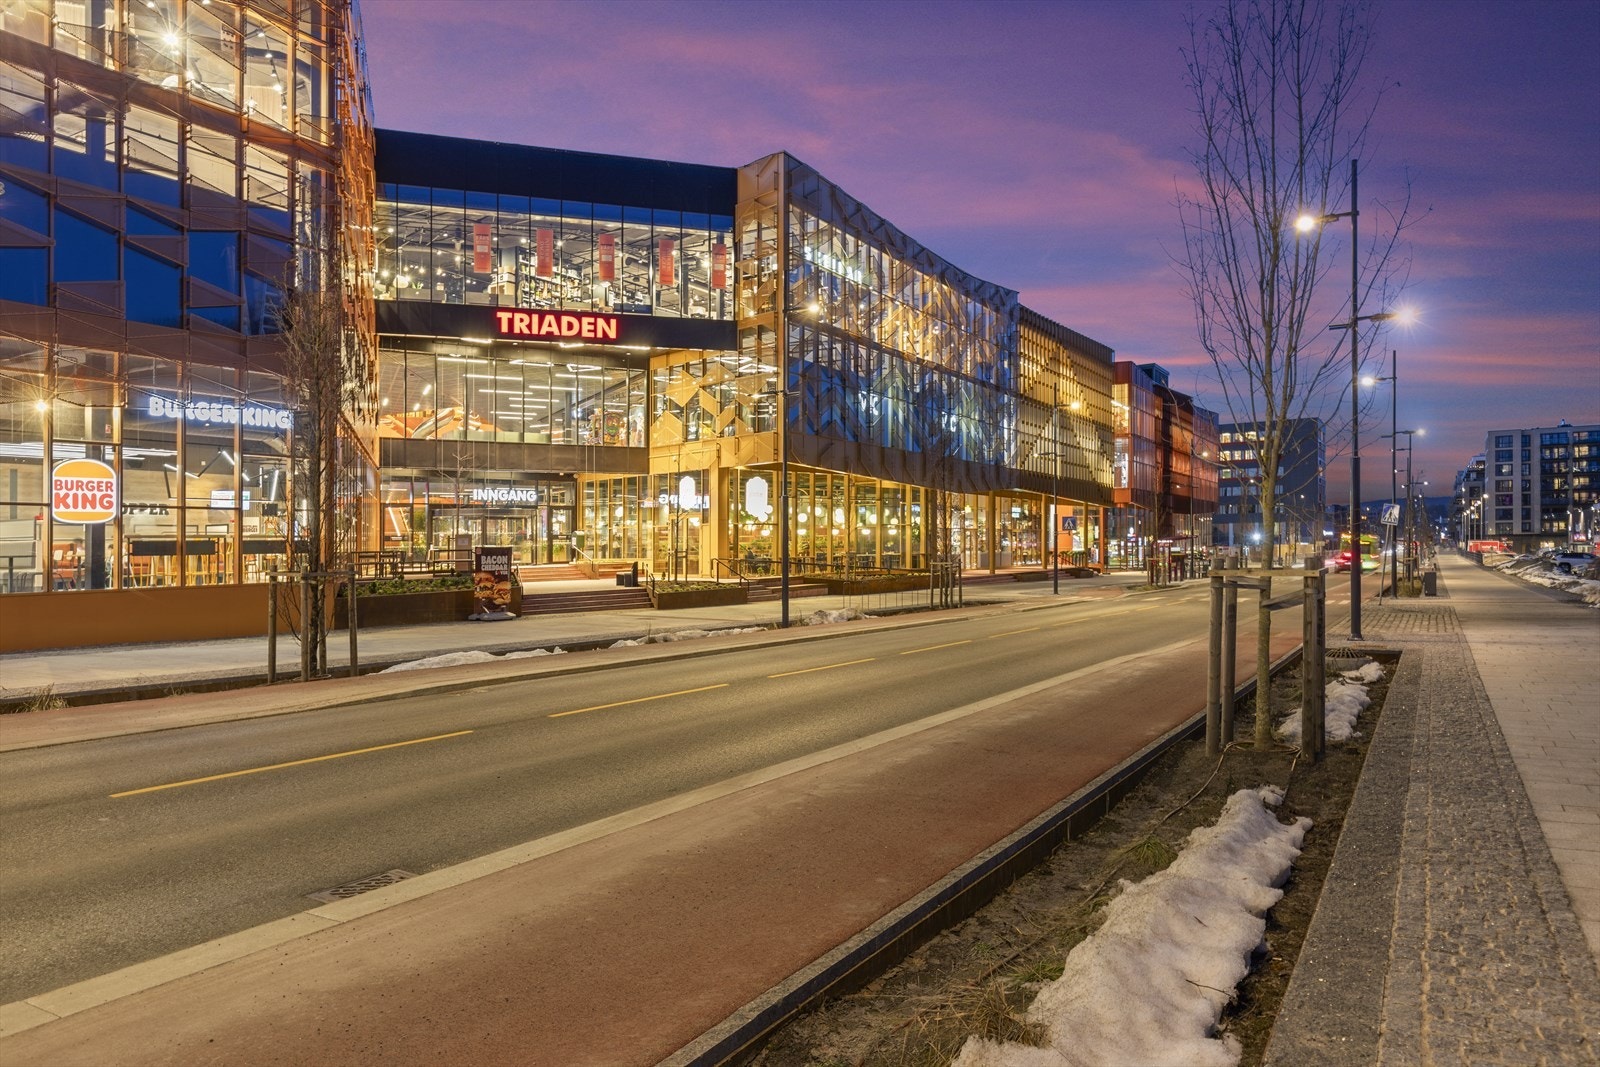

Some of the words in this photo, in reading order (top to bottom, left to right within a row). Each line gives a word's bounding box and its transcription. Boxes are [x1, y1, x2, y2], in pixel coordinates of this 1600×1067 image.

[496, 311, 617, 339] TRIADEN
[148, 396, 240, 424] BURGER
[241, 406, 292, 429] KING
[53, 479, 114, 492] BURGER
[53, 492, 114, 511] KING
[472, 488, 537, 502] INNGANG
[481, 555, 508, 565] BACON
